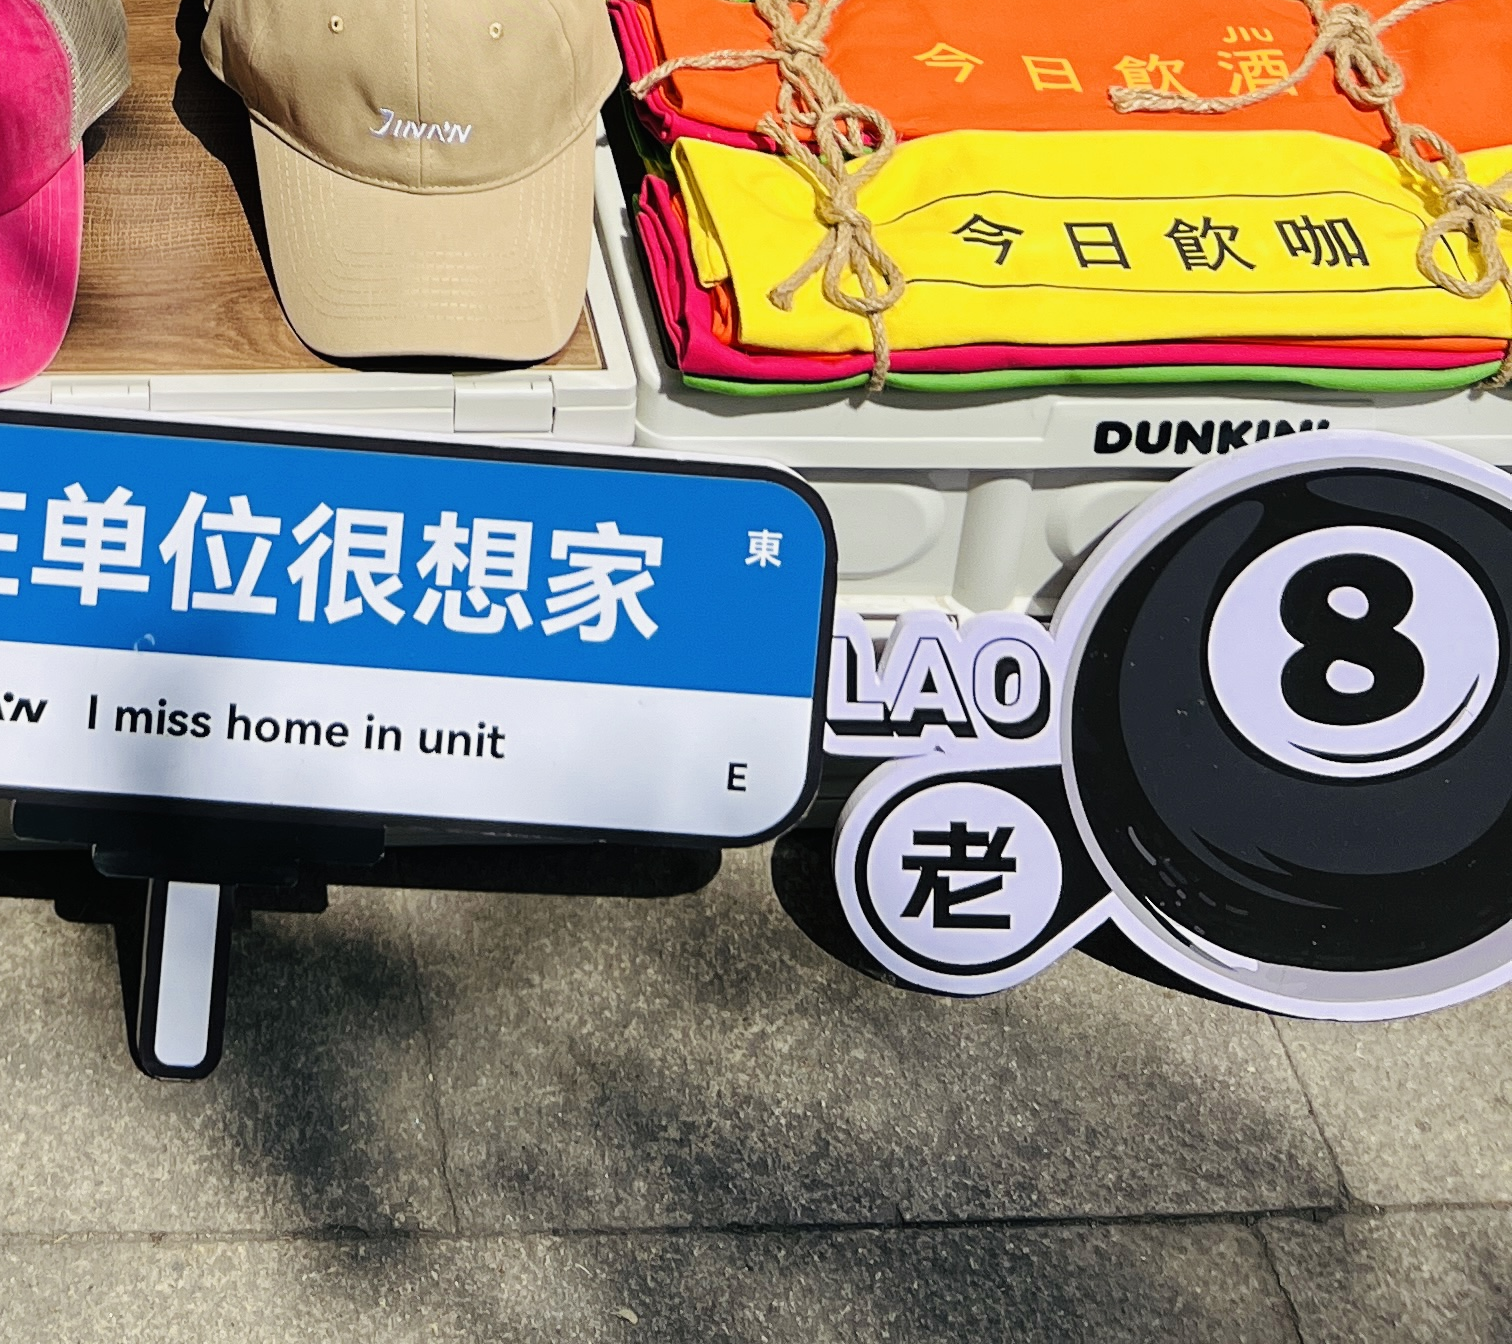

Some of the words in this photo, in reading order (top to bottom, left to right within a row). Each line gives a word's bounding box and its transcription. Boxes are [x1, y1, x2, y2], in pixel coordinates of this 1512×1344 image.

[913, 40, 1300, 98] 今日飲酒
[950, 212, 1372, 271] 今日飲咖
[746, 529, 785, 568] 東
[1280, 553, 1425, 726] 8
[827, 634, 1051, 740] LAO
[88, 697, 99, 731] I
[116, 698, 211, 740] miss
[226, 702, 350, 750] home
[365, 712, 403, 752] in
[417, 718, 506, 761] unit
[728, 762, 748, 792] E
[901, 822, 1018, 930] 老
